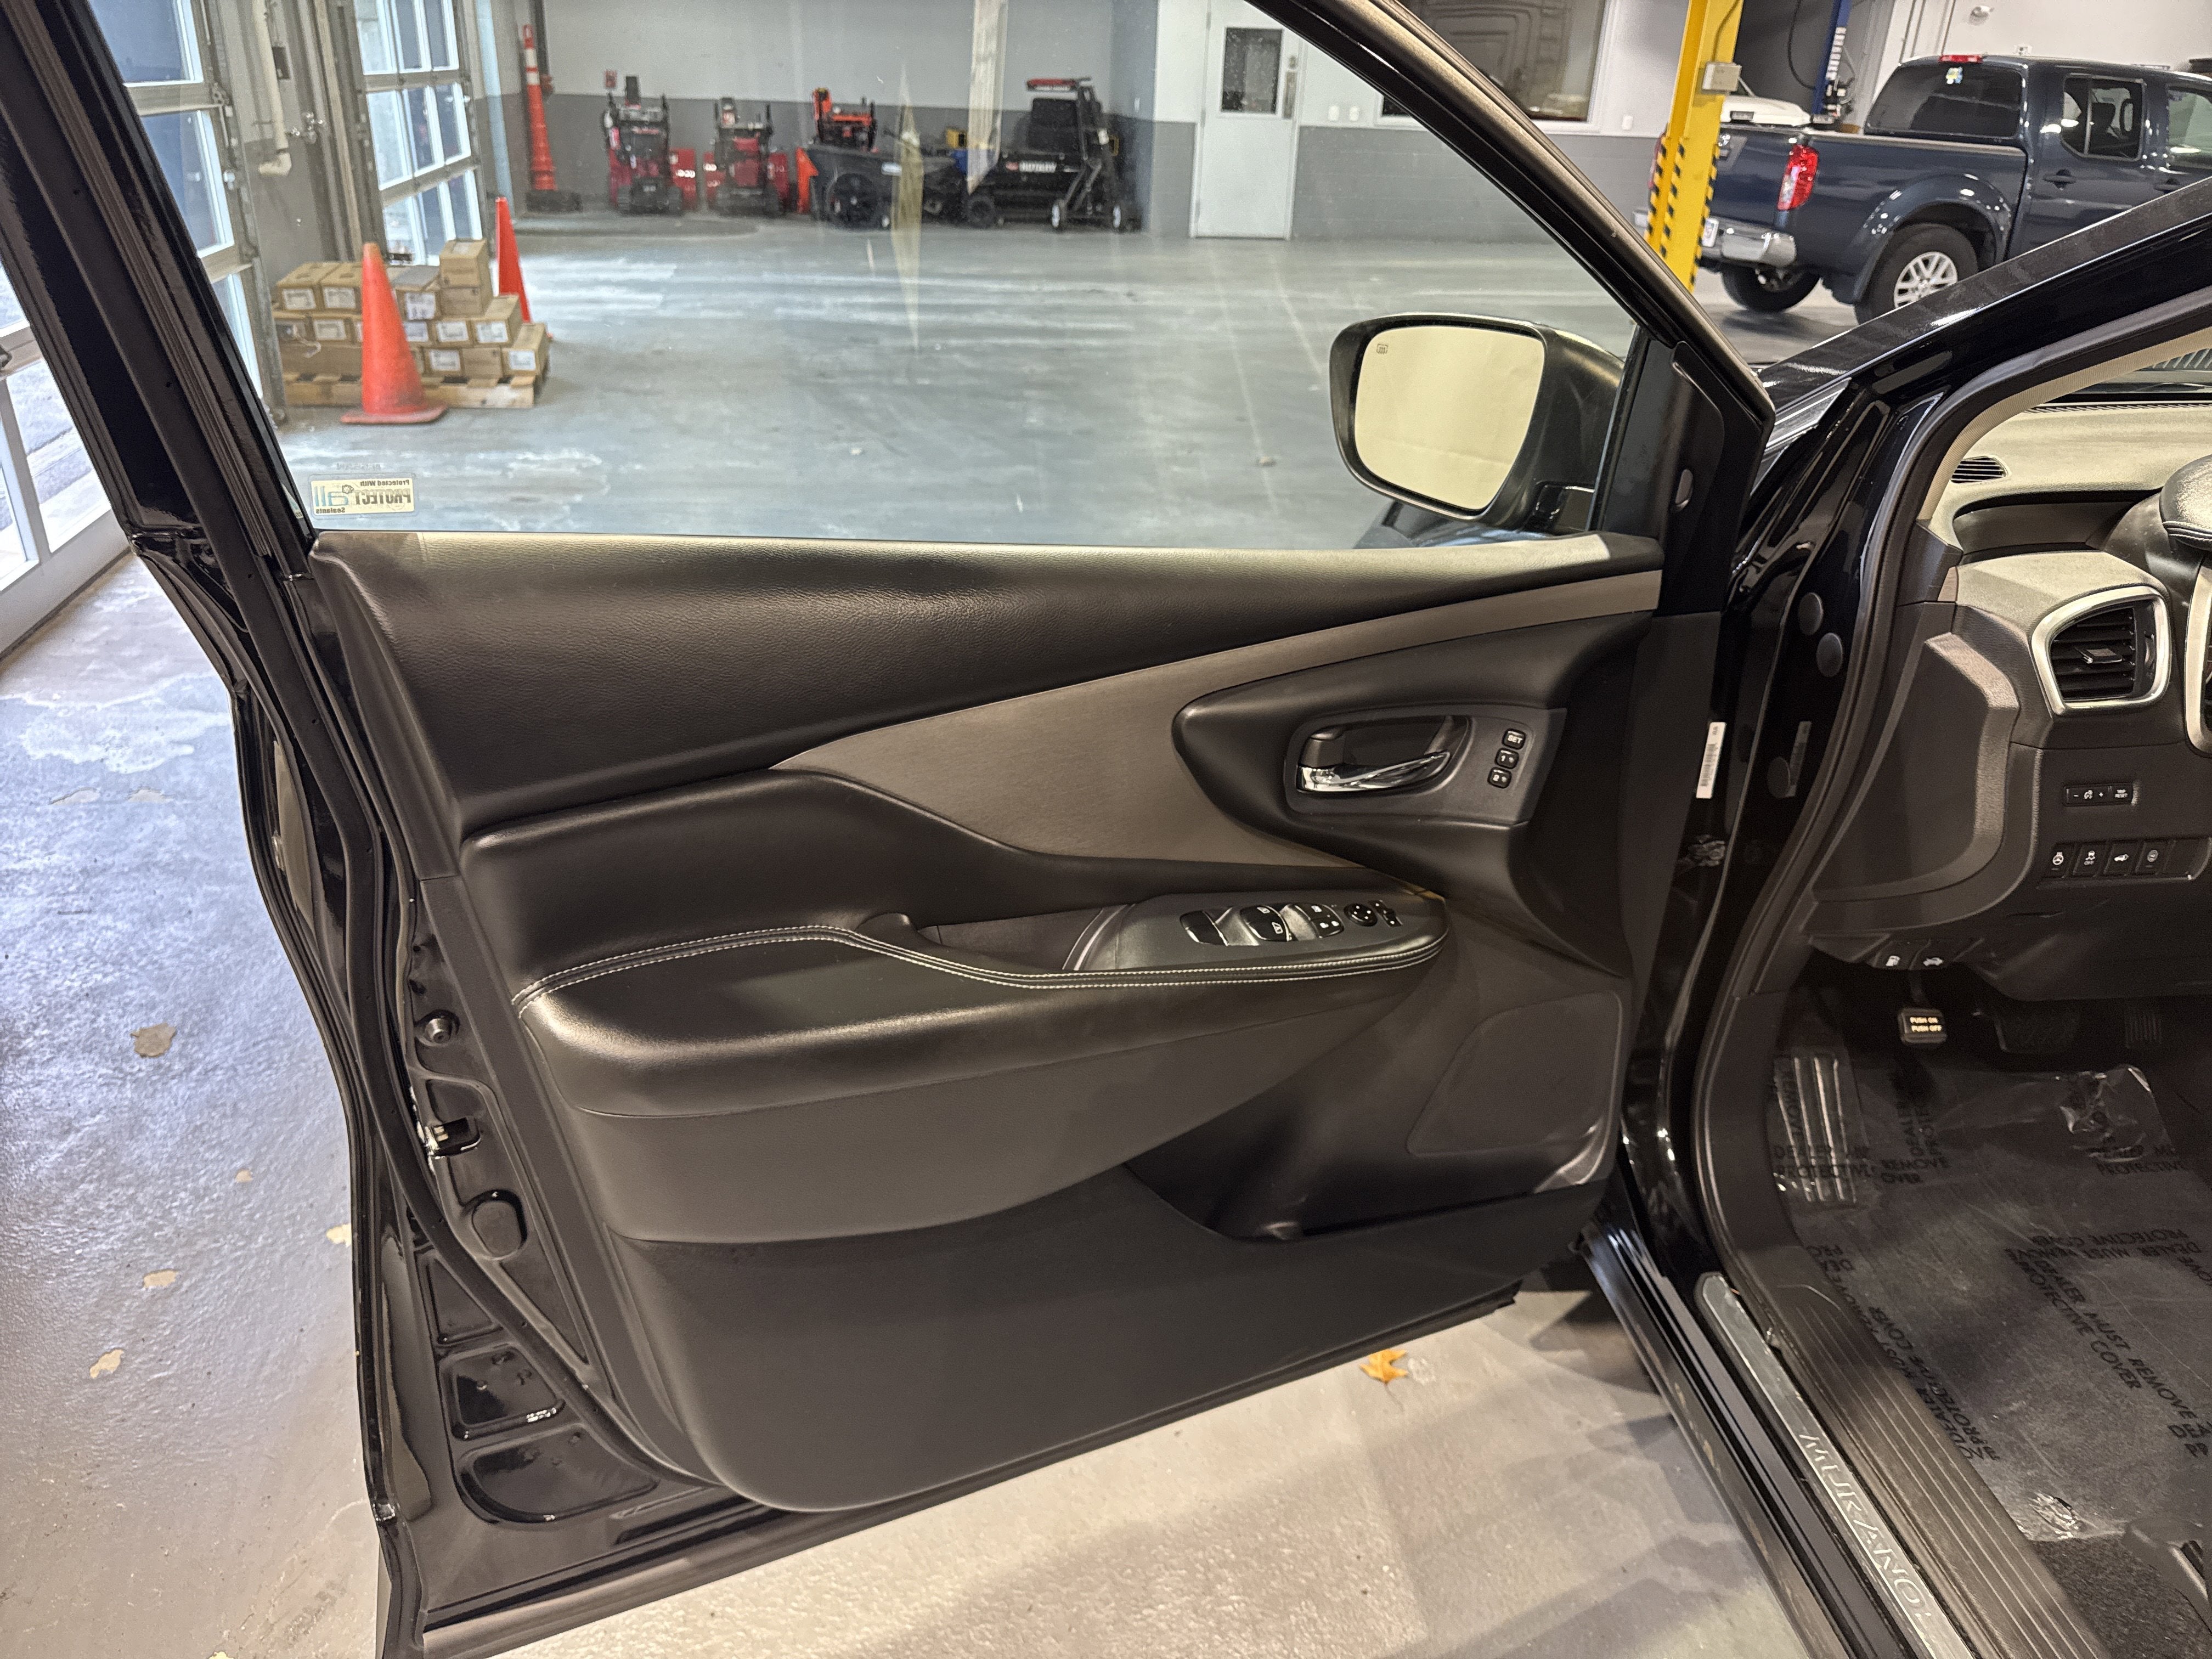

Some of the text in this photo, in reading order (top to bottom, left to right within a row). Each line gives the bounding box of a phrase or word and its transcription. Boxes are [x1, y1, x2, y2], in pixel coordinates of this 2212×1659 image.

[1508, 735, 1523, 744] SET
[2089, 1229, 2189, 1245] PROTECTIVE
[2084, 1248, 2130, 1259] MUST
[2138, 1242, 2202, 1257] DEALER
[2034, 1260, 2086, 1304] DEALER
[2083, 1312, 2131, 1350] MUST
[2128, 1357, 2198, 1419] REMOVE
[2090, 1340, 2142, 1389] COVER
[1799, 1434, 1925, 1609] MURANO
